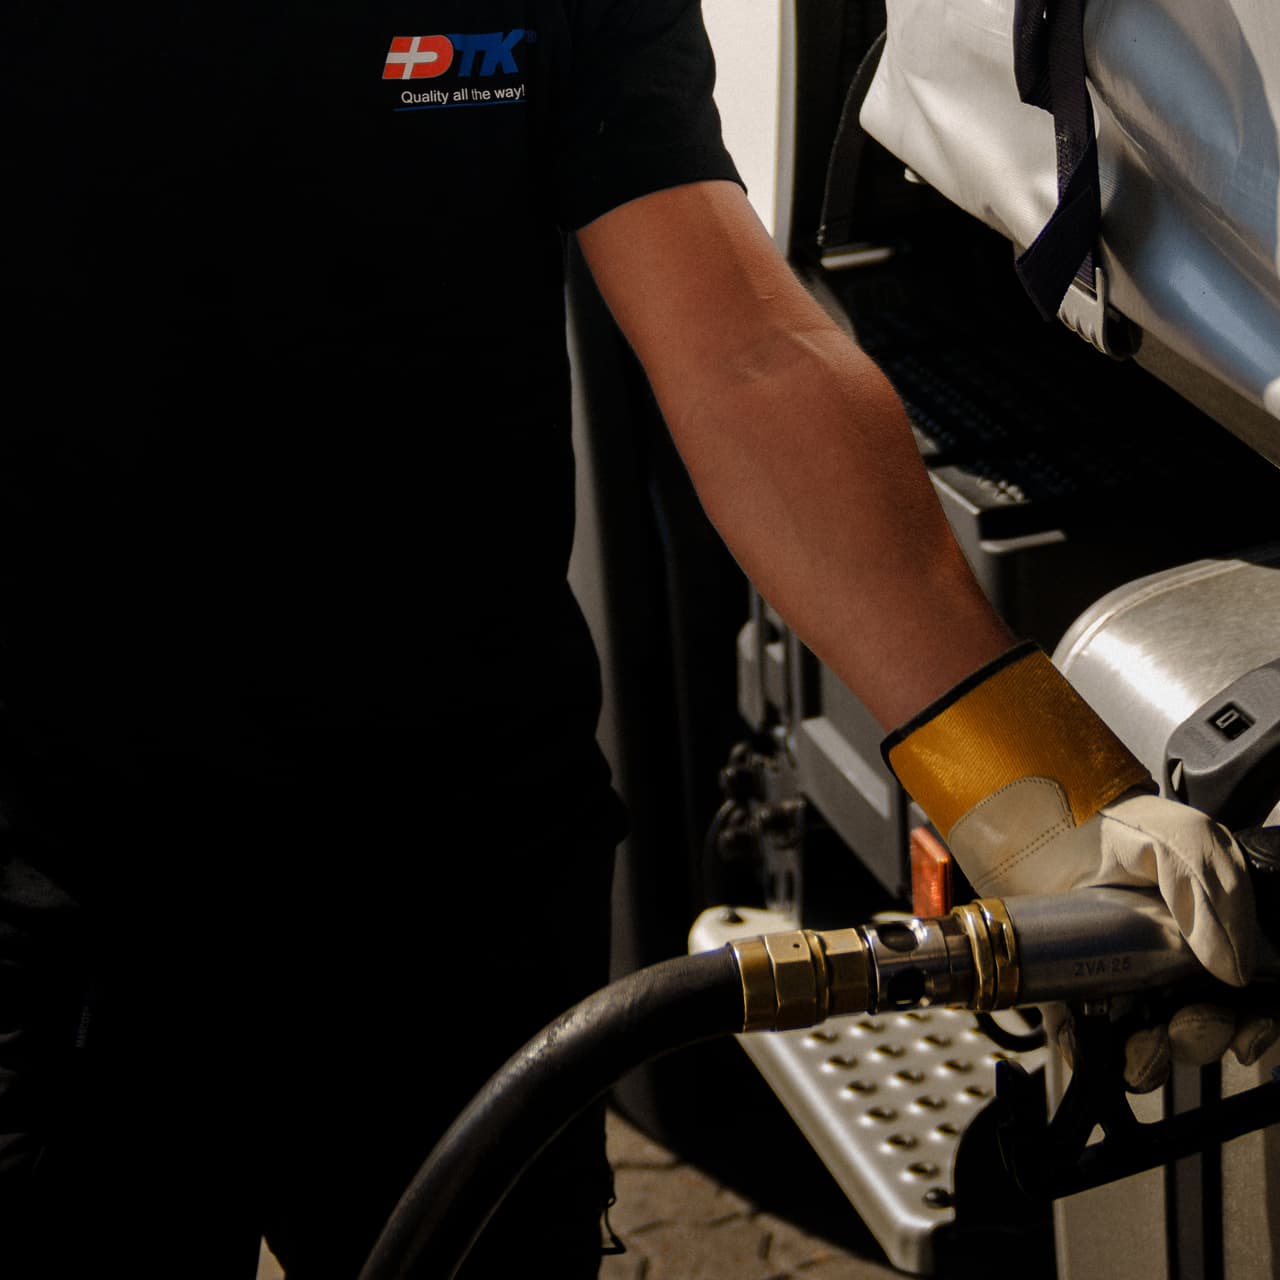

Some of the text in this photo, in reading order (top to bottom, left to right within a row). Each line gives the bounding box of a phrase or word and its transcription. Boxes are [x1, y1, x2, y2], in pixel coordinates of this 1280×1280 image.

[401, 83, 526, 105] Quality all the way!
